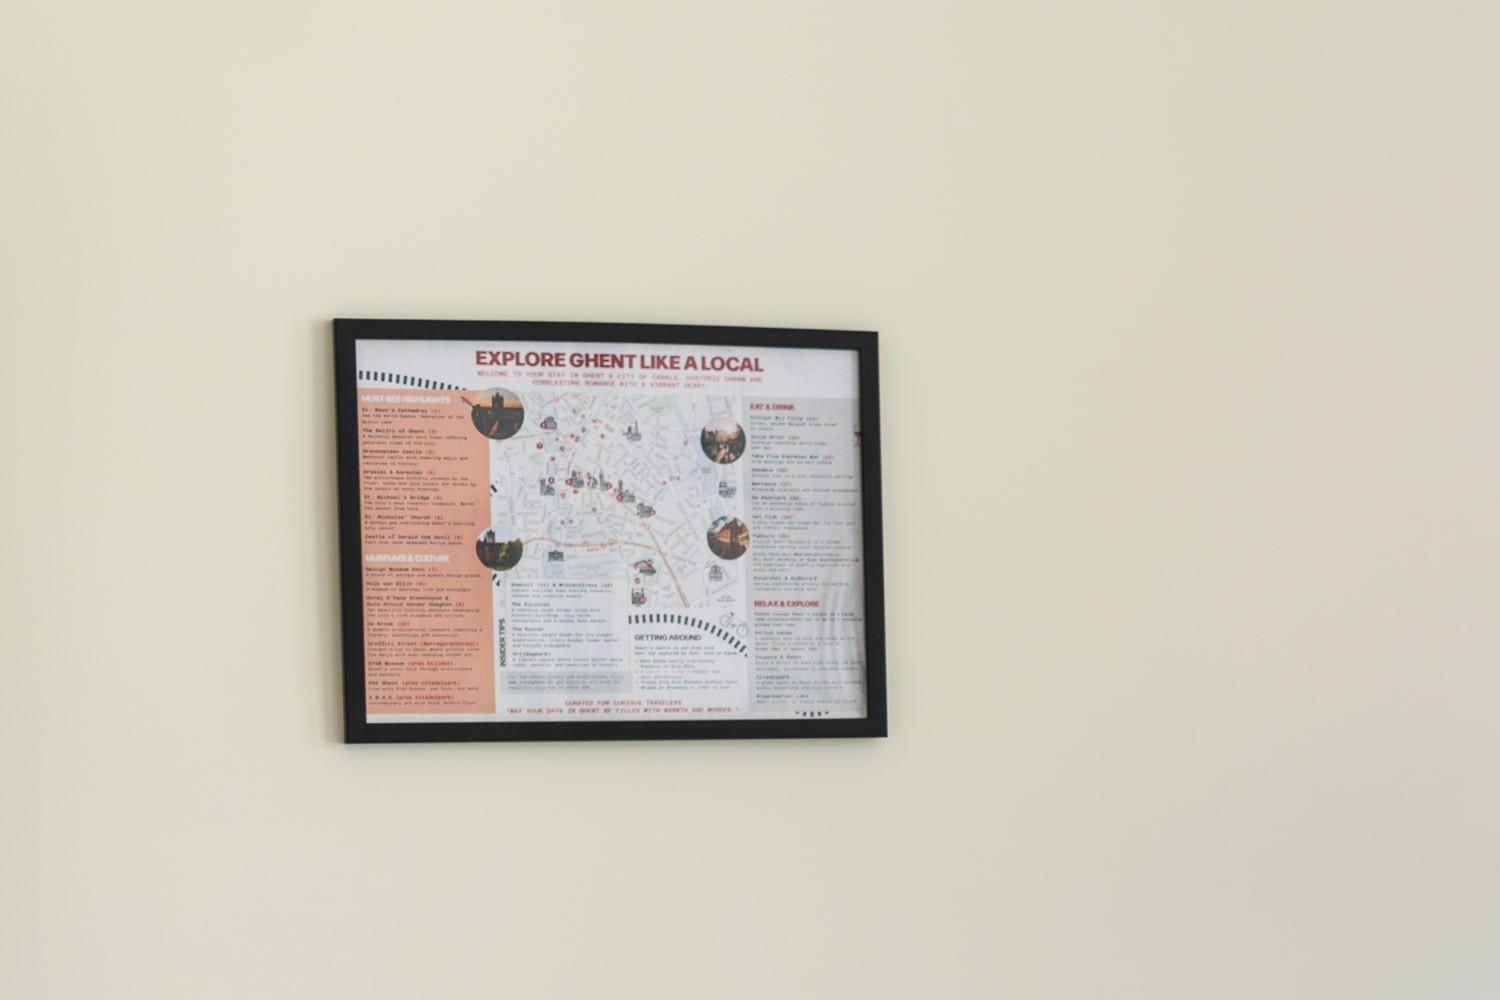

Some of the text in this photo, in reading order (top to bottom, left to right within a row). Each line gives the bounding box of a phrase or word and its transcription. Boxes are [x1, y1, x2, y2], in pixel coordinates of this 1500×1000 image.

[476, 351, 764, 372] EXPLORE GHENT LIKE A LOCAL
